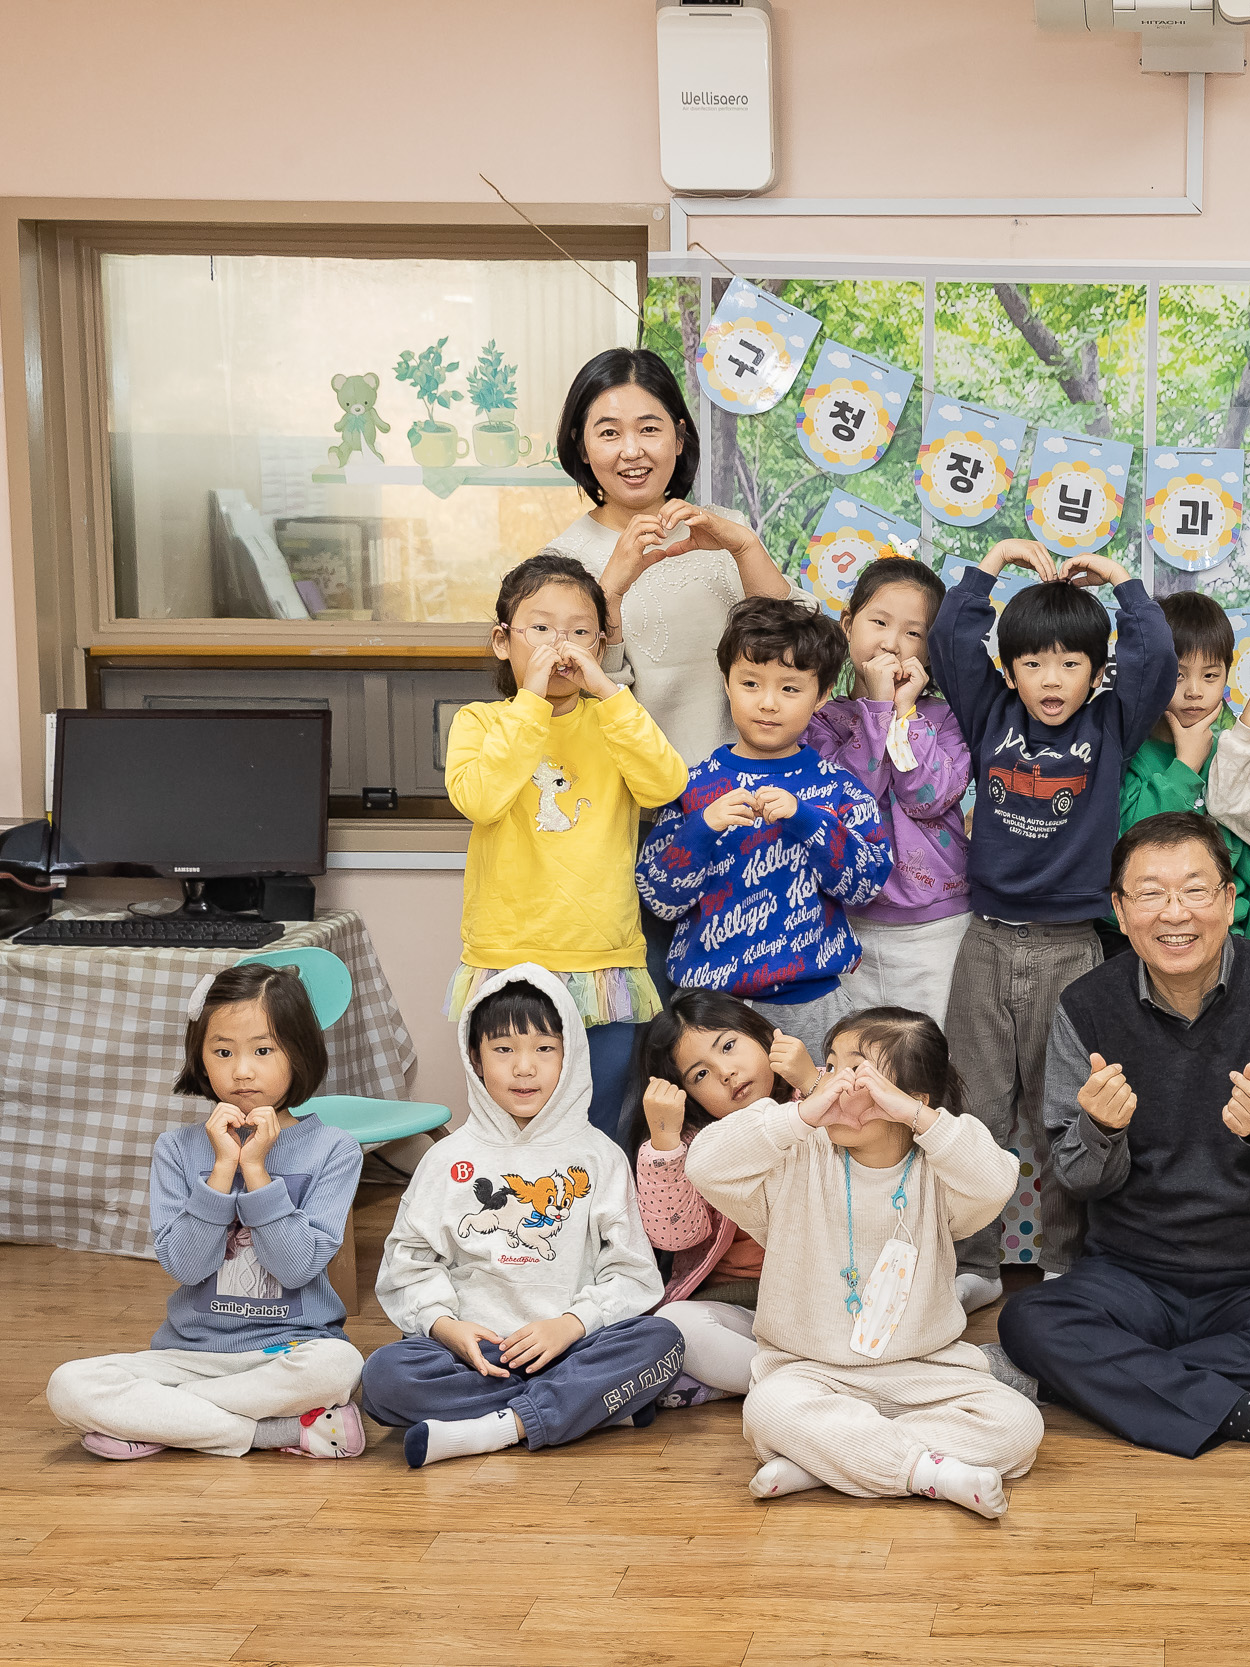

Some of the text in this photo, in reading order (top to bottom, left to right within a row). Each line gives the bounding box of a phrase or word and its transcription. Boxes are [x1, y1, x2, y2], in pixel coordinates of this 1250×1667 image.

[681, 91, 749, 105] Wellisaero
[700, 892, 778, 952] Kellogg's
[743, 933, 788, 964] Kellogg's
[680, 956, 739, 990] Kellogg's
[211, 1301, 289, 1318] Smile jealoisy
